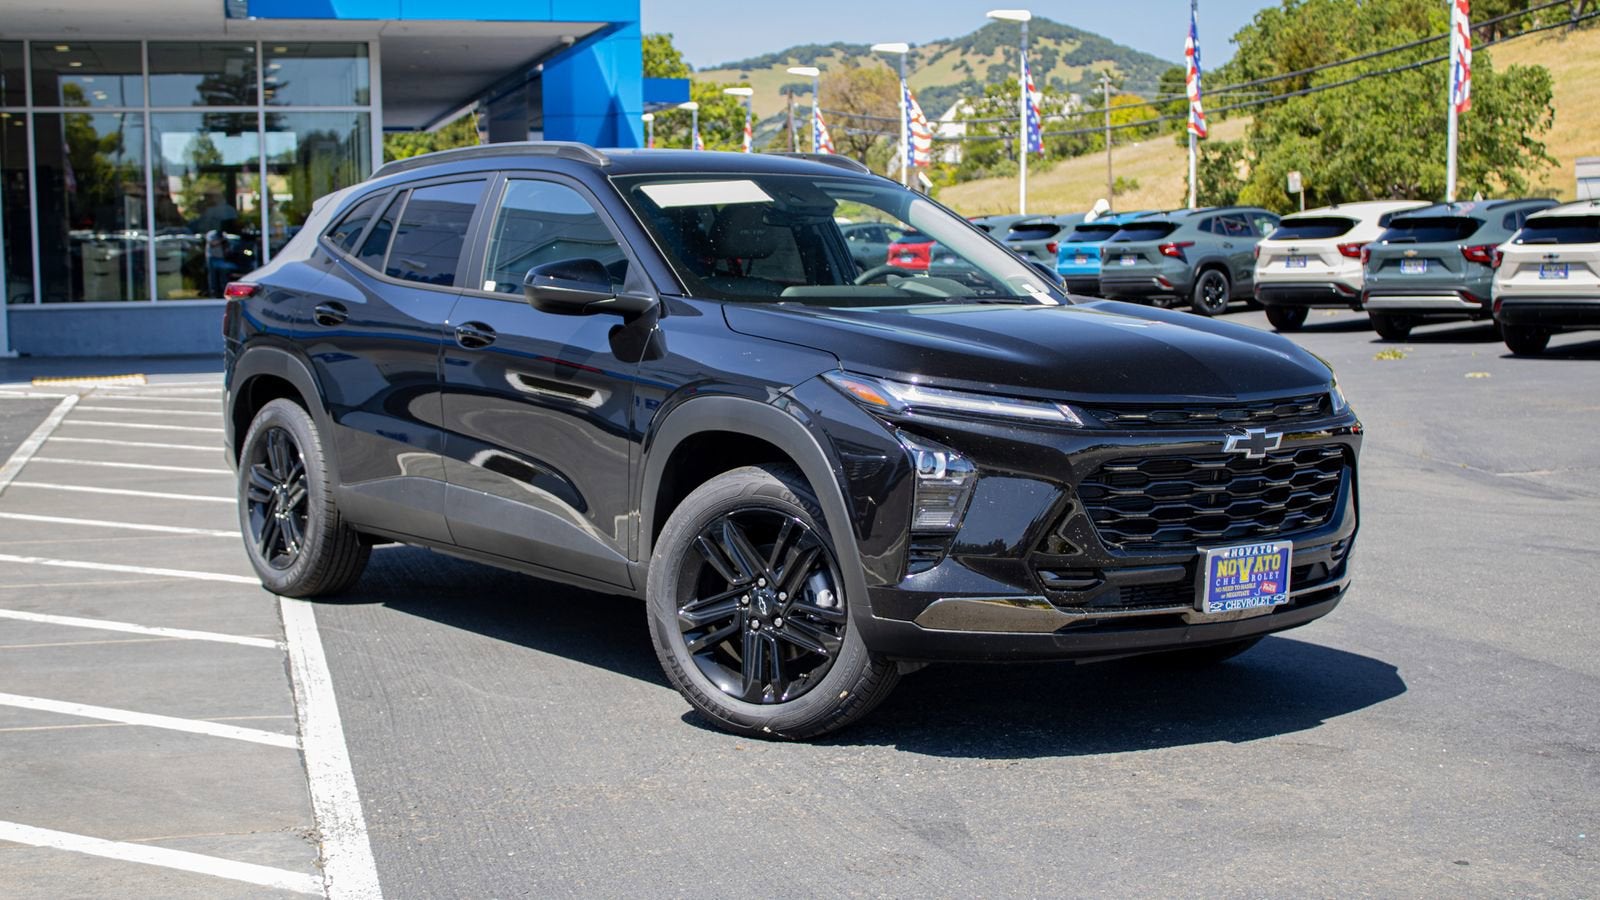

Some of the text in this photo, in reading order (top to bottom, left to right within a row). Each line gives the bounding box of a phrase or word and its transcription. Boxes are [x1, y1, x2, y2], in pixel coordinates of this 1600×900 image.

[1231, 545, 1272, 557] NOVATO
[1217, 554, 1281, 583] NOVATO
[1225, 596, 1272, 610] CHEVROLET
